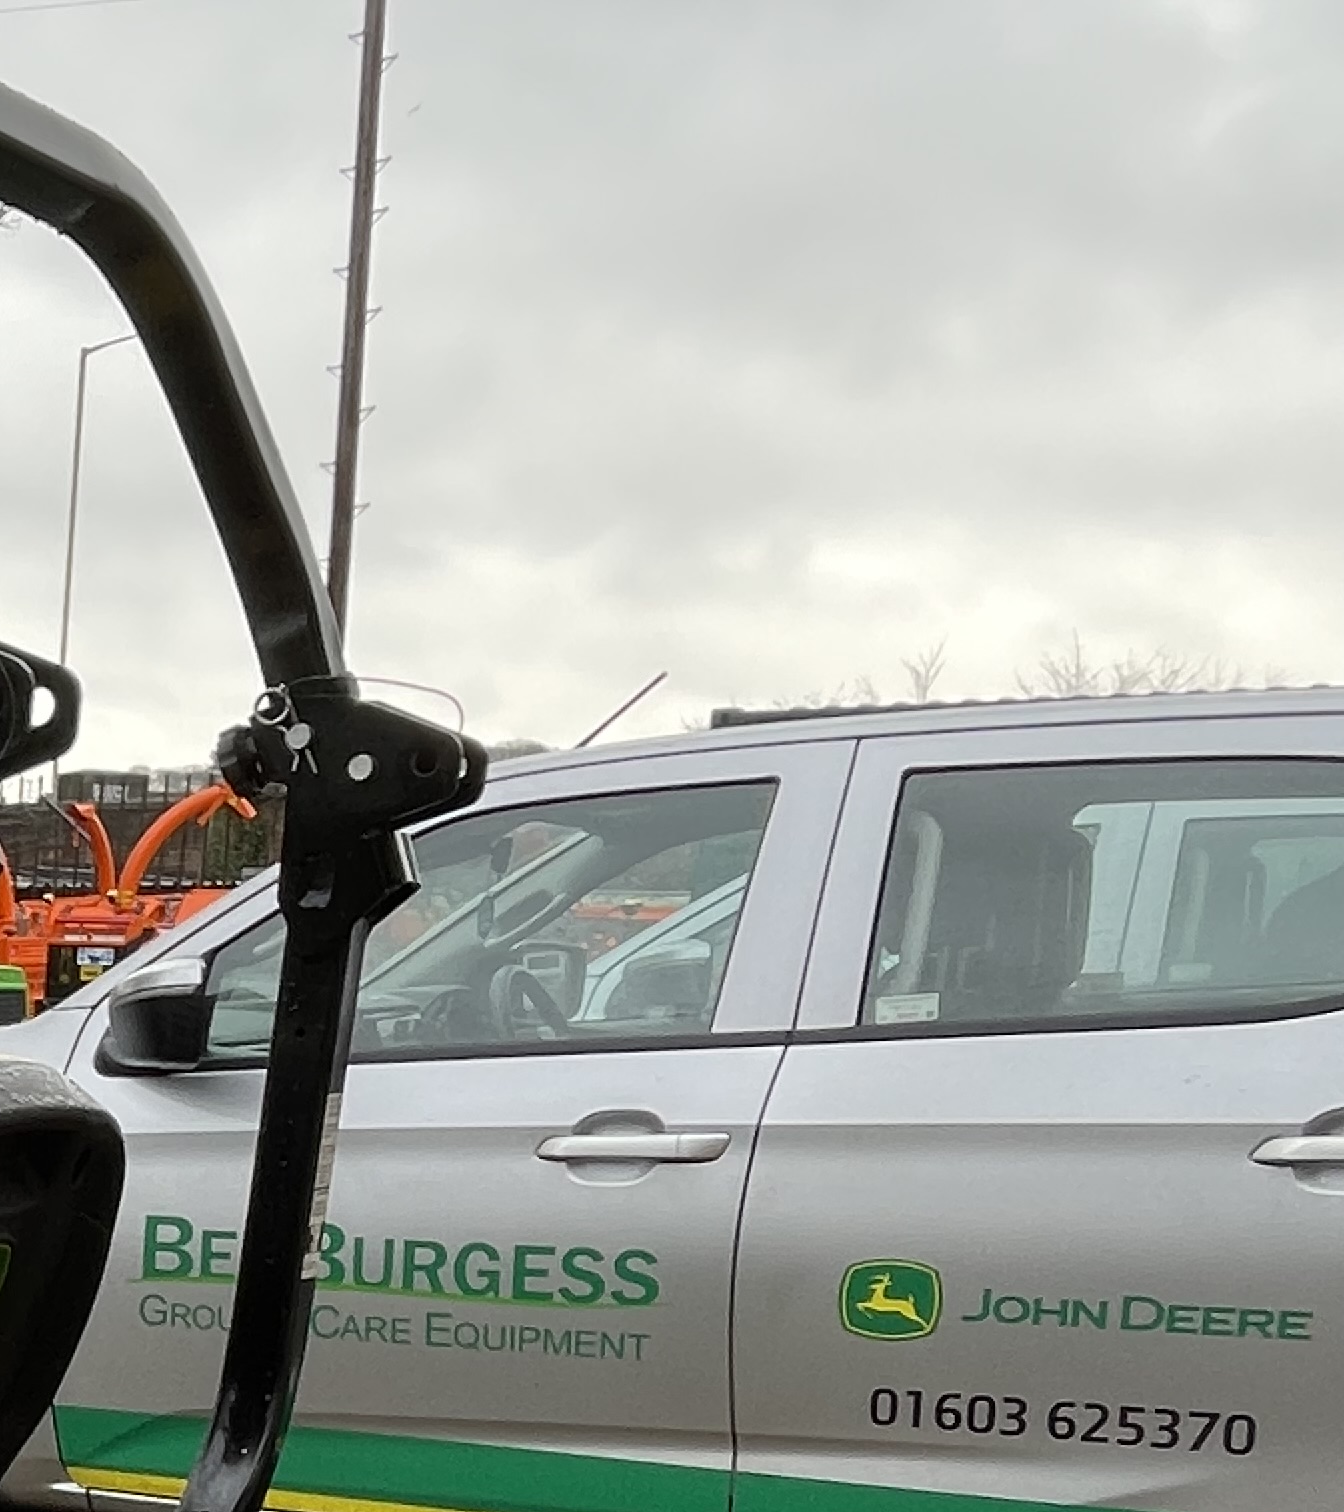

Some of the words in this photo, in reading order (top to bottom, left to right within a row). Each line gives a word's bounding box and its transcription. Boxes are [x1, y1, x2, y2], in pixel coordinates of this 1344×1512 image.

[142, 1214, 239, 1279] BE
[315, 1222, 660, 1305] BURGESS
[311, 1303, 413, 1346] CARE
[425, 1311, 651, 1362] EQUIPMENT
[961, 1288, 1109, 1330] JOHN
[1119, 1295, 1313, 1341] DEERE
[868, 1387, 1028, 1437] 01603
[1047, 1400, 1257, 1456] 625370
